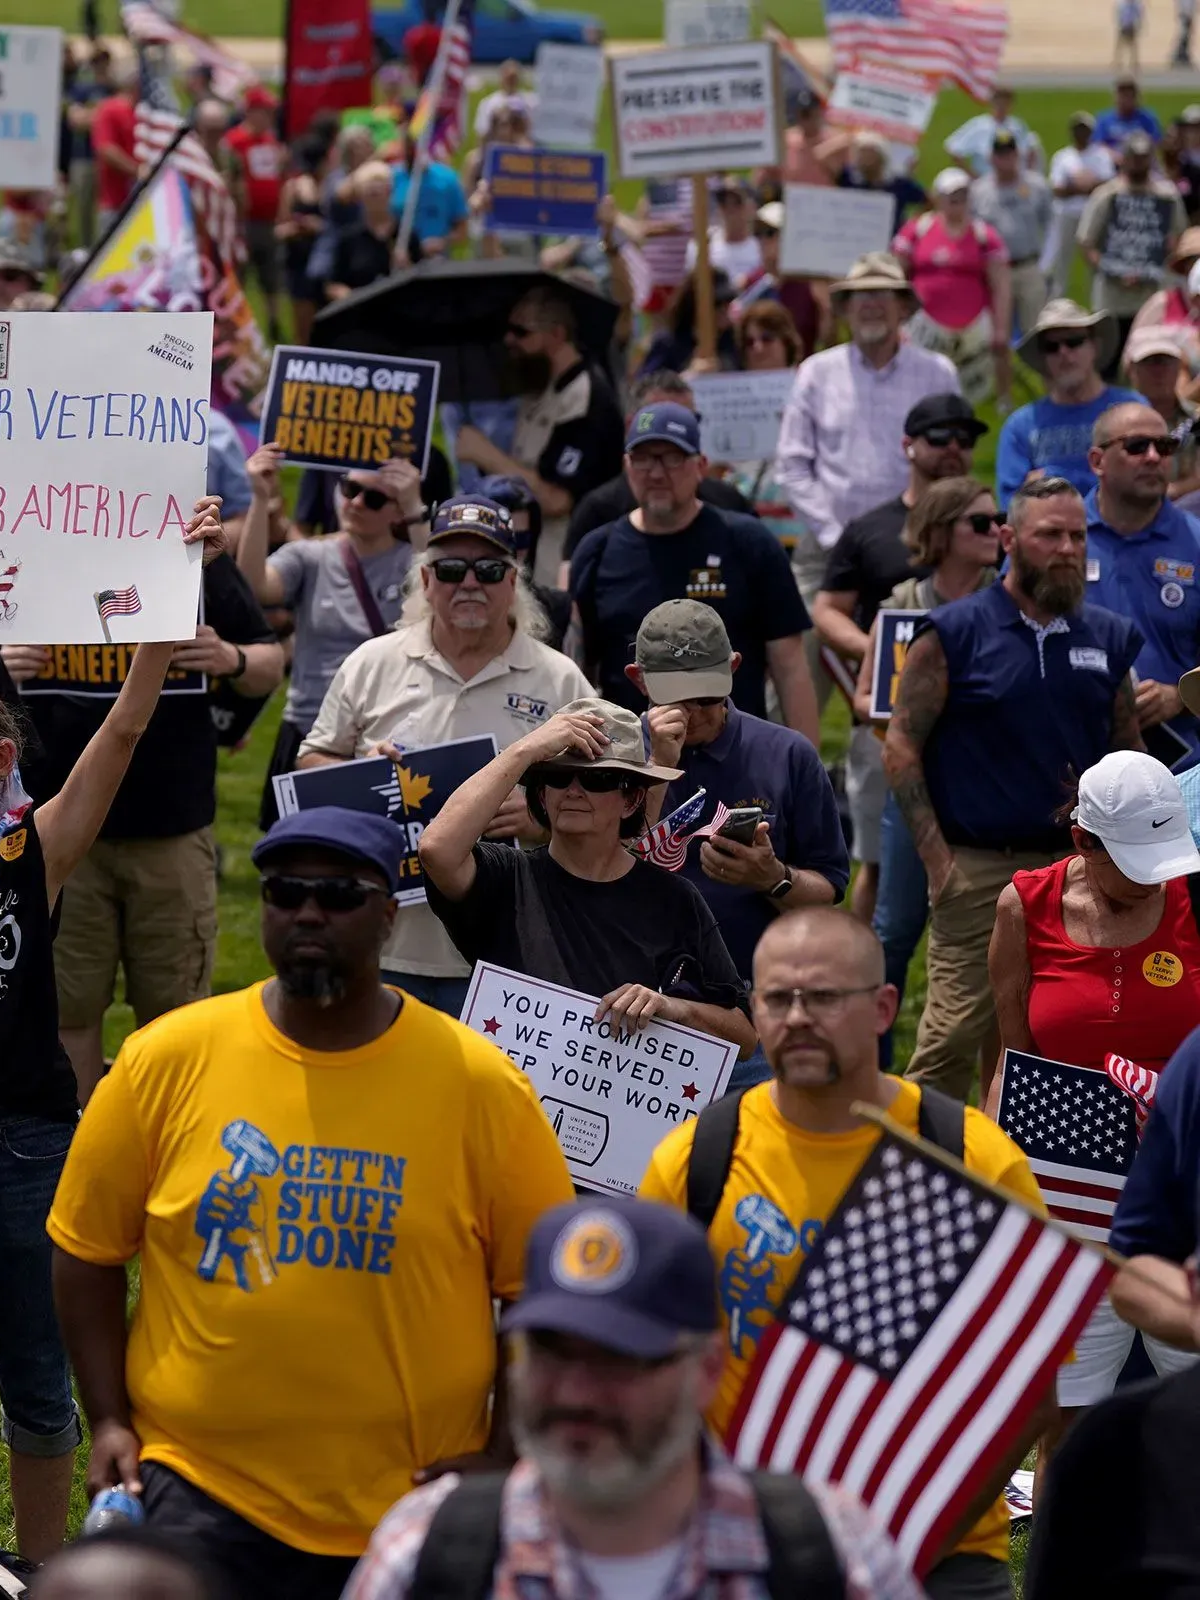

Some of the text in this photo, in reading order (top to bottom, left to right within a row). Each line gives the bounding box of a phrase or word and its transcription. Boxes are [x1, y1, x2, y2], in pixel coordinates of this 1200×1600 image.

[147, 344, 193, 370] AMERICAN
[163, 333, 194, 352] PROUD
[285, 359, 420, 393] HANDS OFF
[27, 388, 209, 446] VETERANS
[281, 380, 417, 430] VETERANS
[274, 415, 392, 464] BENEFITS
[10, 482, 187, 540] AMERICA
[1145, 971, 1176, 984] VETERANS
[502, 989, 699, 1071] YOU PROMISED.
[516, 1023, 669, 1090] WE SERVED.
[551, 1062, 612, 1098] YOUR
[564, 1133, 581, 1143] UNITE
[568, 1125, 599, 1140] VETERANS.
[570, 1116, 600, 1130] UNITE FOR
[283, 1144, 407, 1189] GETT'N
[277, 1180, 403, 1231] STUFF
[277, 1224, 396, 1275] DONE
